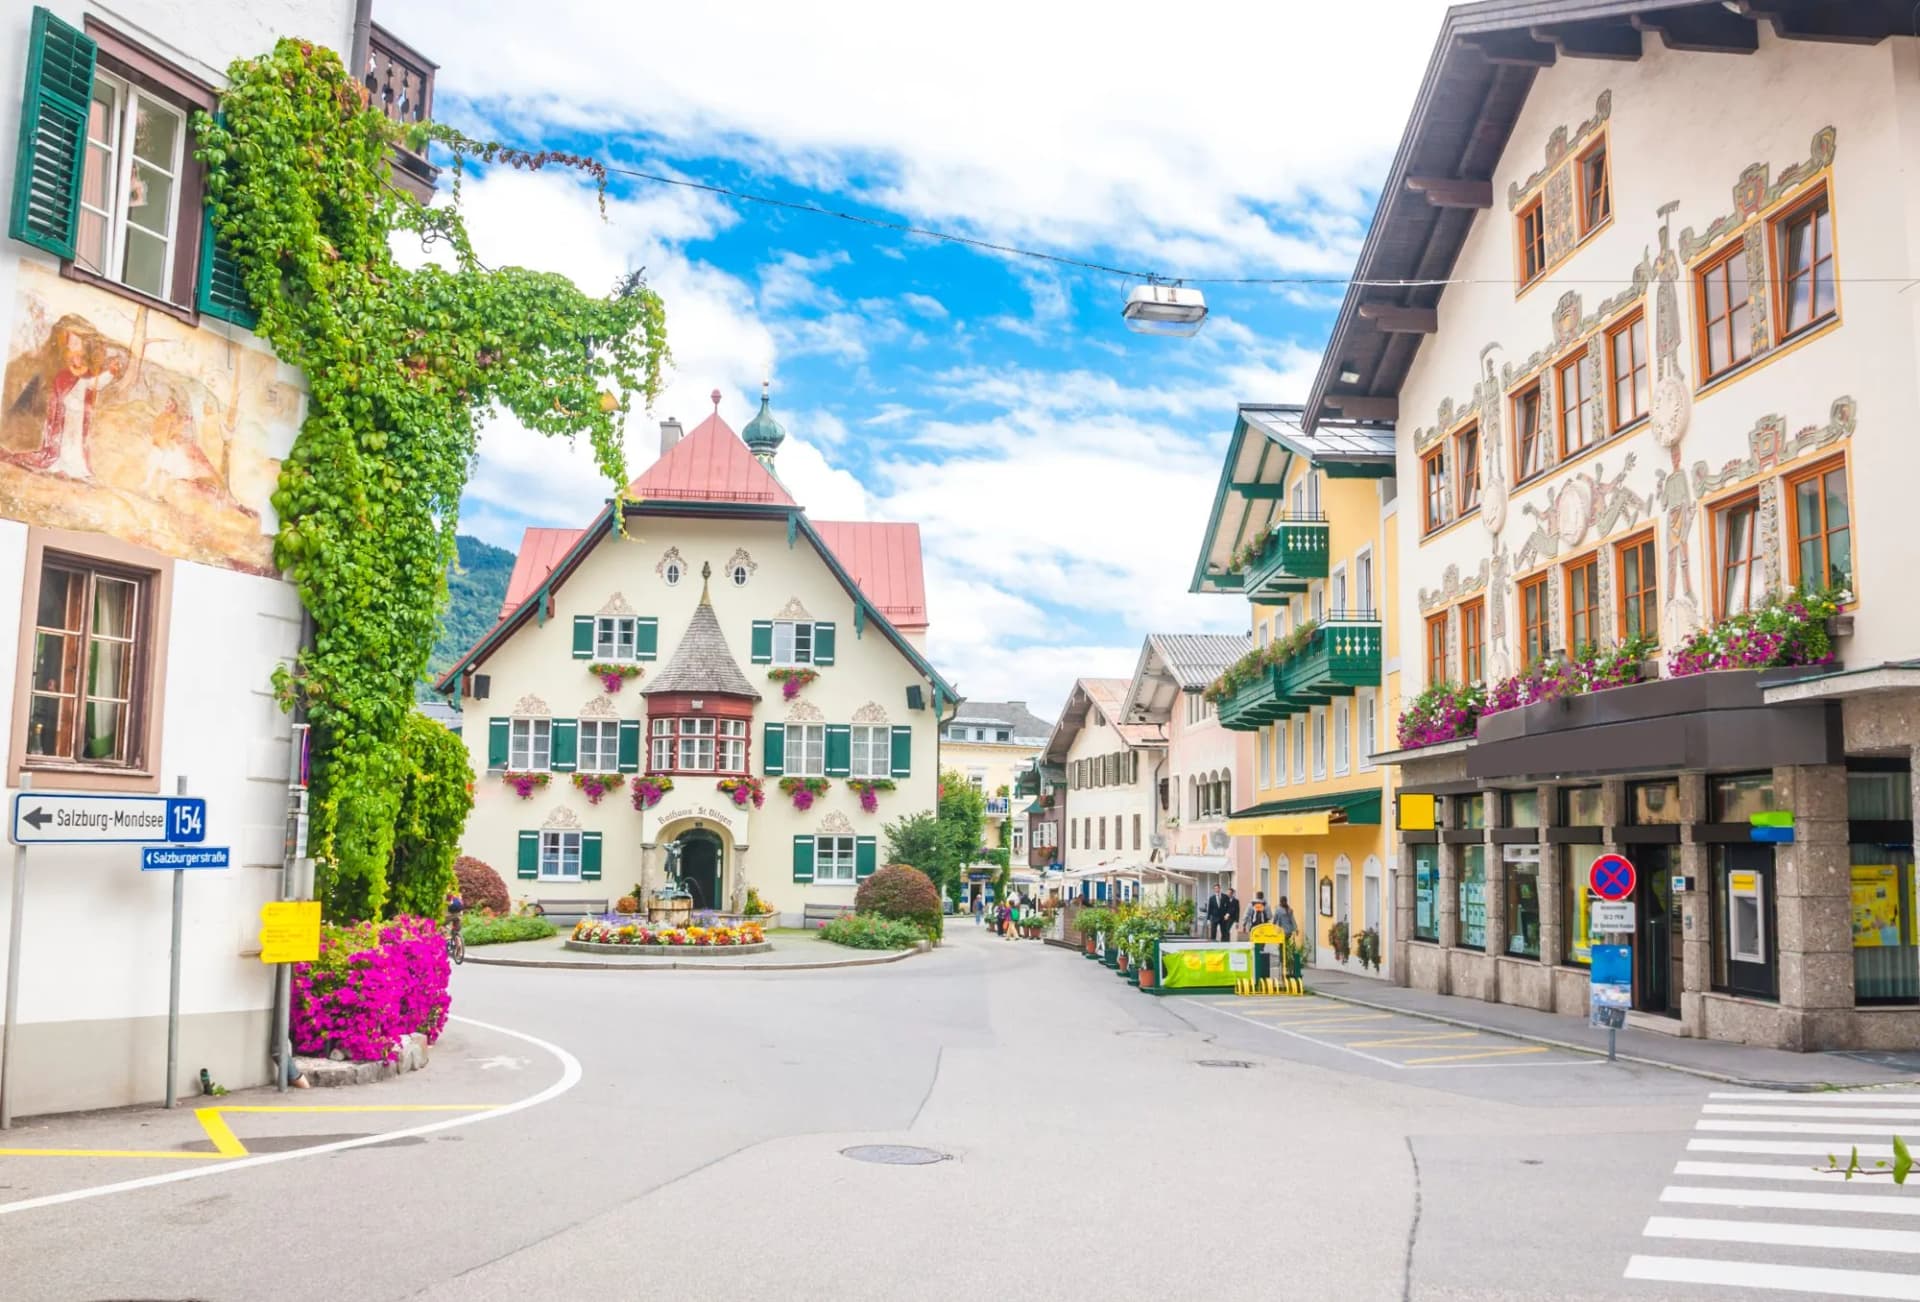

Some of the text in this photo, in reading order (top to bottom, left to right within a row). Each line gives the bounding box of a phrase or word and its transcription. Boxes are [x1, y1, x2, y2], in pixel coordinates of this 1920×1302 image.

[57, 808, 164, 831] Salzburg-Mondsee
[173, 805, 202, 835] 154
[153, 851, 227, 867] Salzburgerstraße
